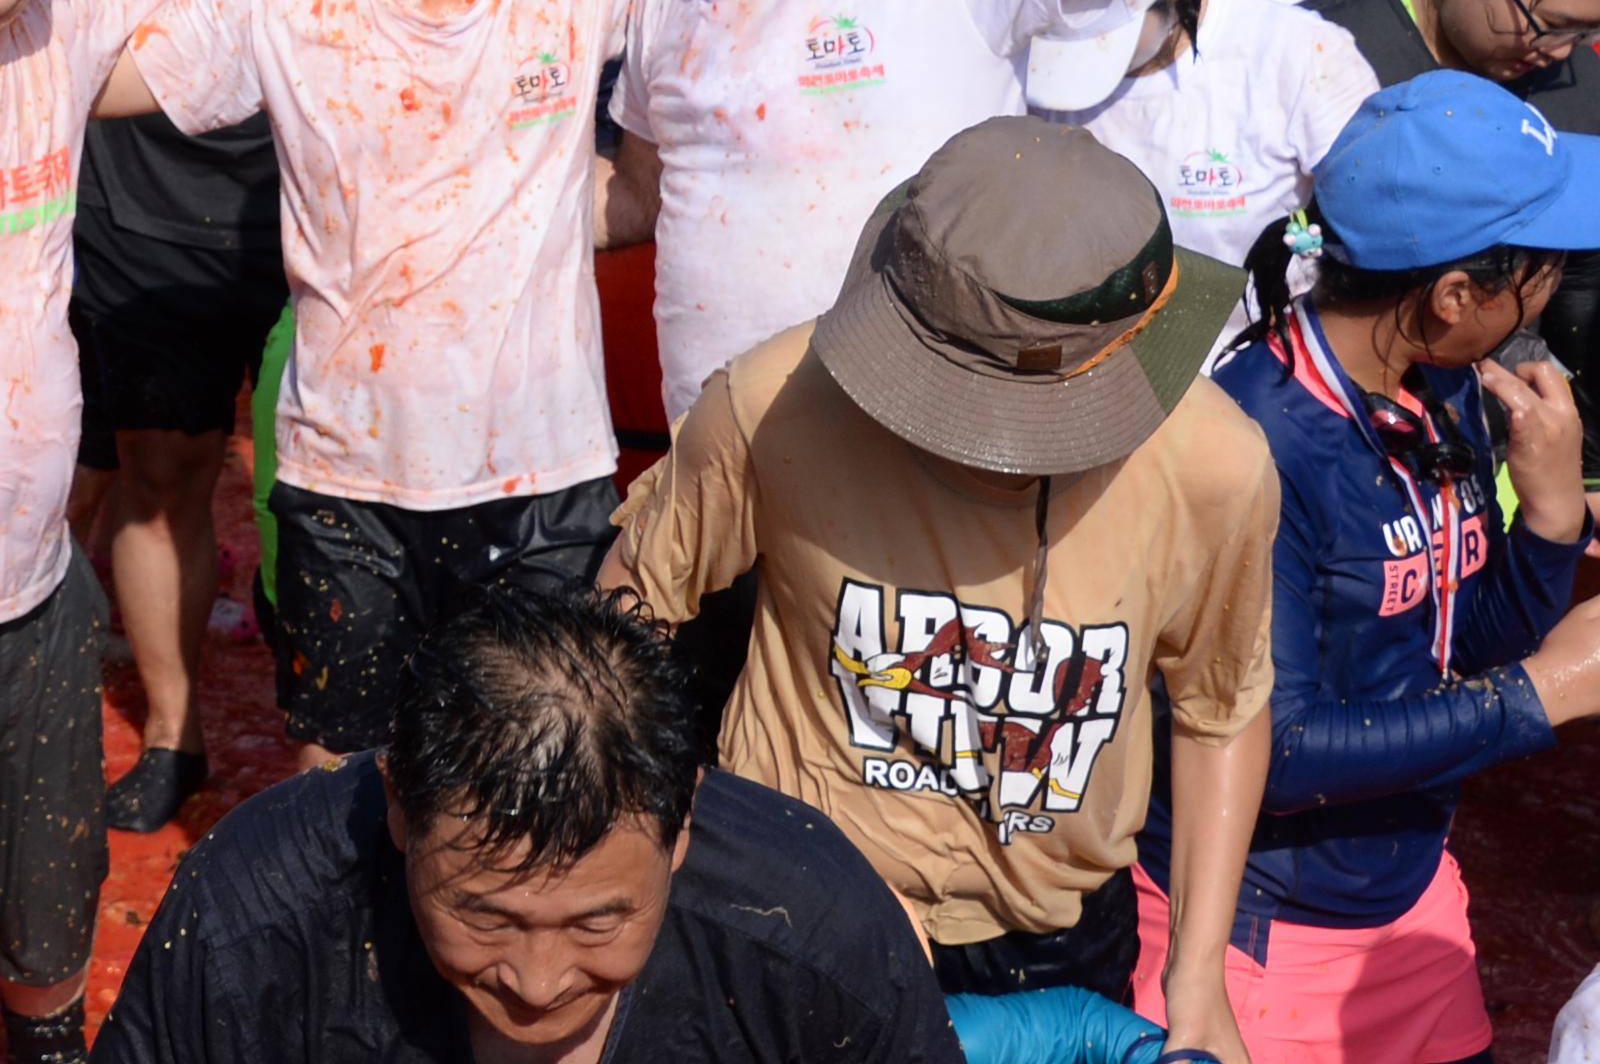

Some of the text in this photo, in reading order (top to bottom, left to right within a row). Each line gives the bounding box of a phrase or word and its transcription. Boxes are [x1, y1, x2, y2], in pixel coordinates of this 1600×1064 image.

[803, 31, 865, 62] 토마토
[514, 66, 566, 98] 토마토
[1179, 165, 1233, 187] 토마토
[1384, 564, 1399, 613] STREET
